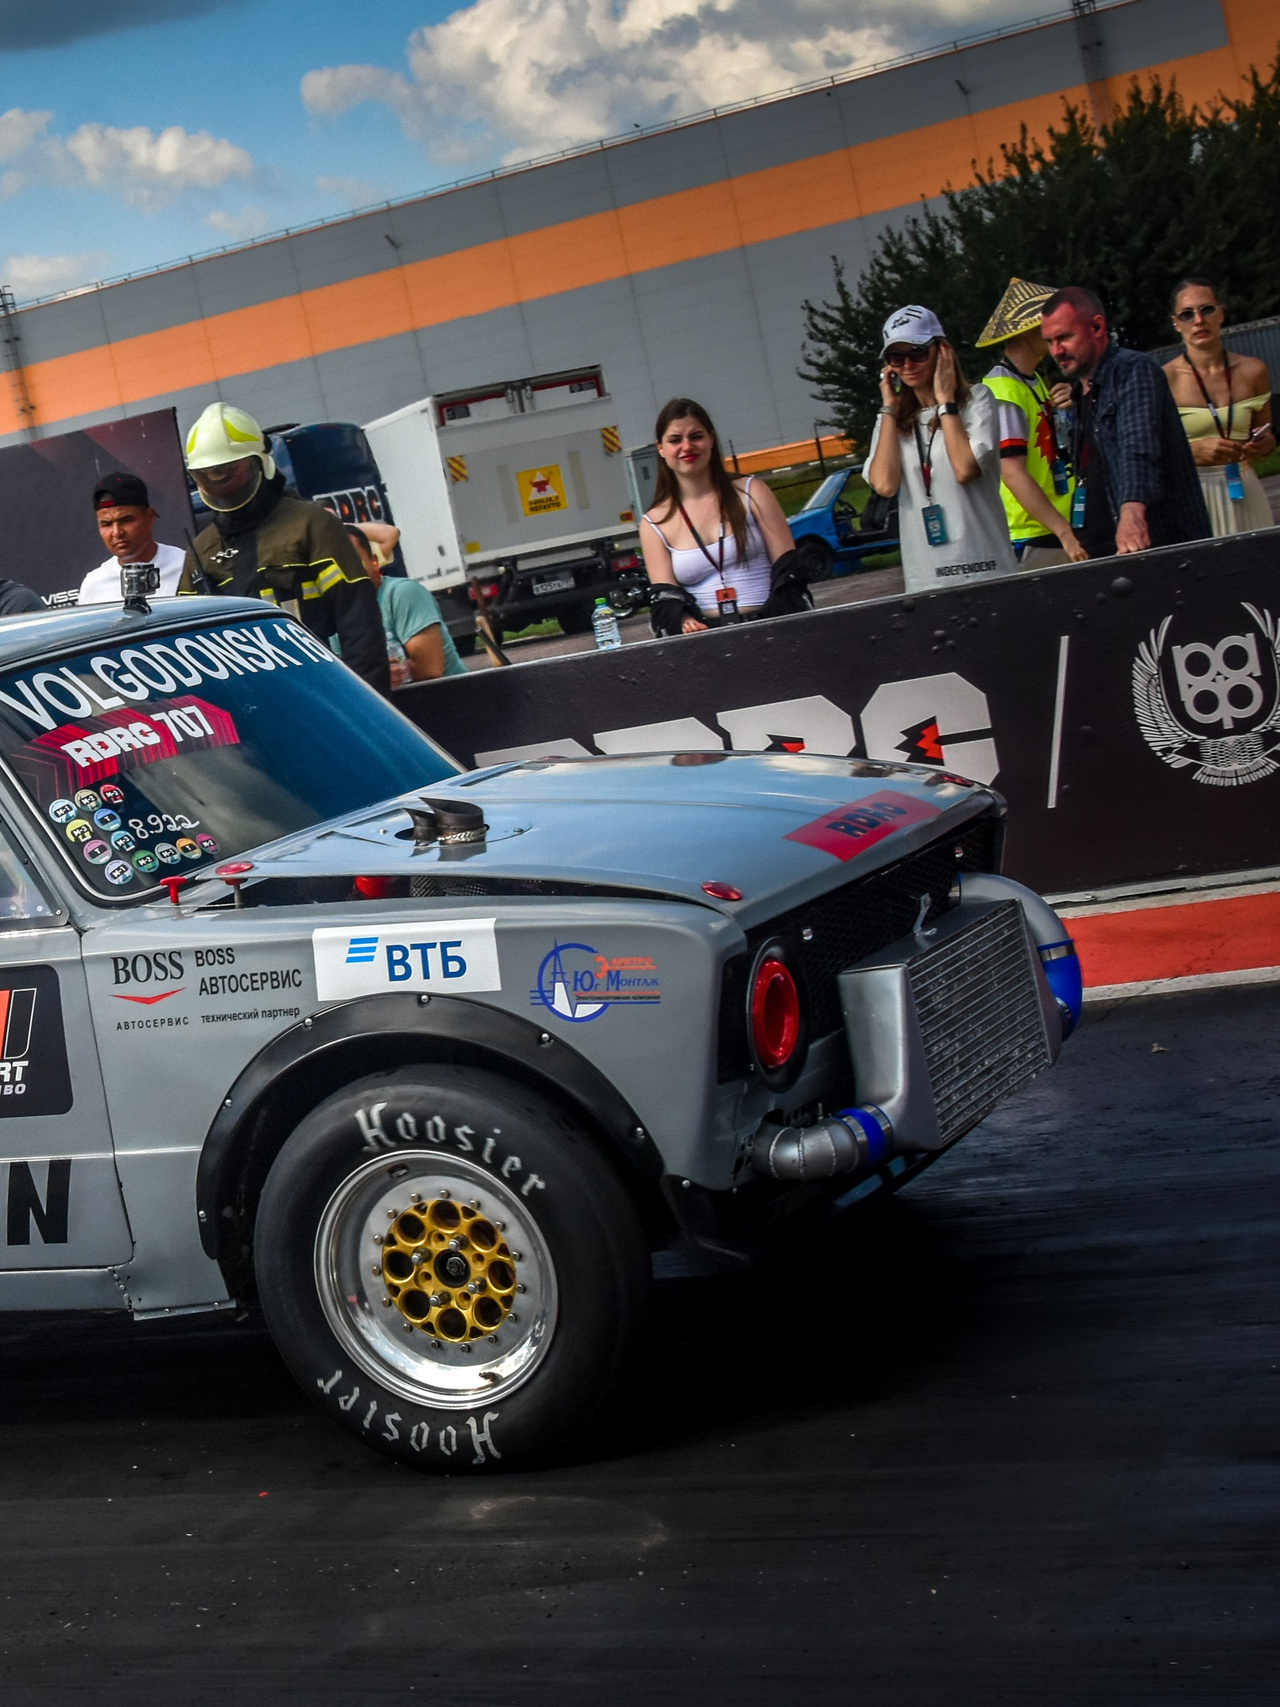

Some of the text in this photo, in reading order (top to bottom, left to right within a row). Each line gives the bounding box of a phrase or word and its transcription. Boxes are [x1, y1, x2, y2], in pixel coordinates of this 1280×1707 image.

[61, 706, 214, 768] RDRC 707
[128, 814, 200, 839] 8.922
[110, 951, 184, 985] BOSS
[195, 947, 236, 967] BOSS
[386, 940, 467, 981] ВТБ
[199, 968, 302, 996] АВТОСЕРВИС
[116, 1016, 190, 1031] АВТОСЕРВИС
[201, 1007, 300, 1023] технический партнер
[354, 1102, 546, 1197] Hoosier
[317, 1369, 501, 1465] Hoosier
